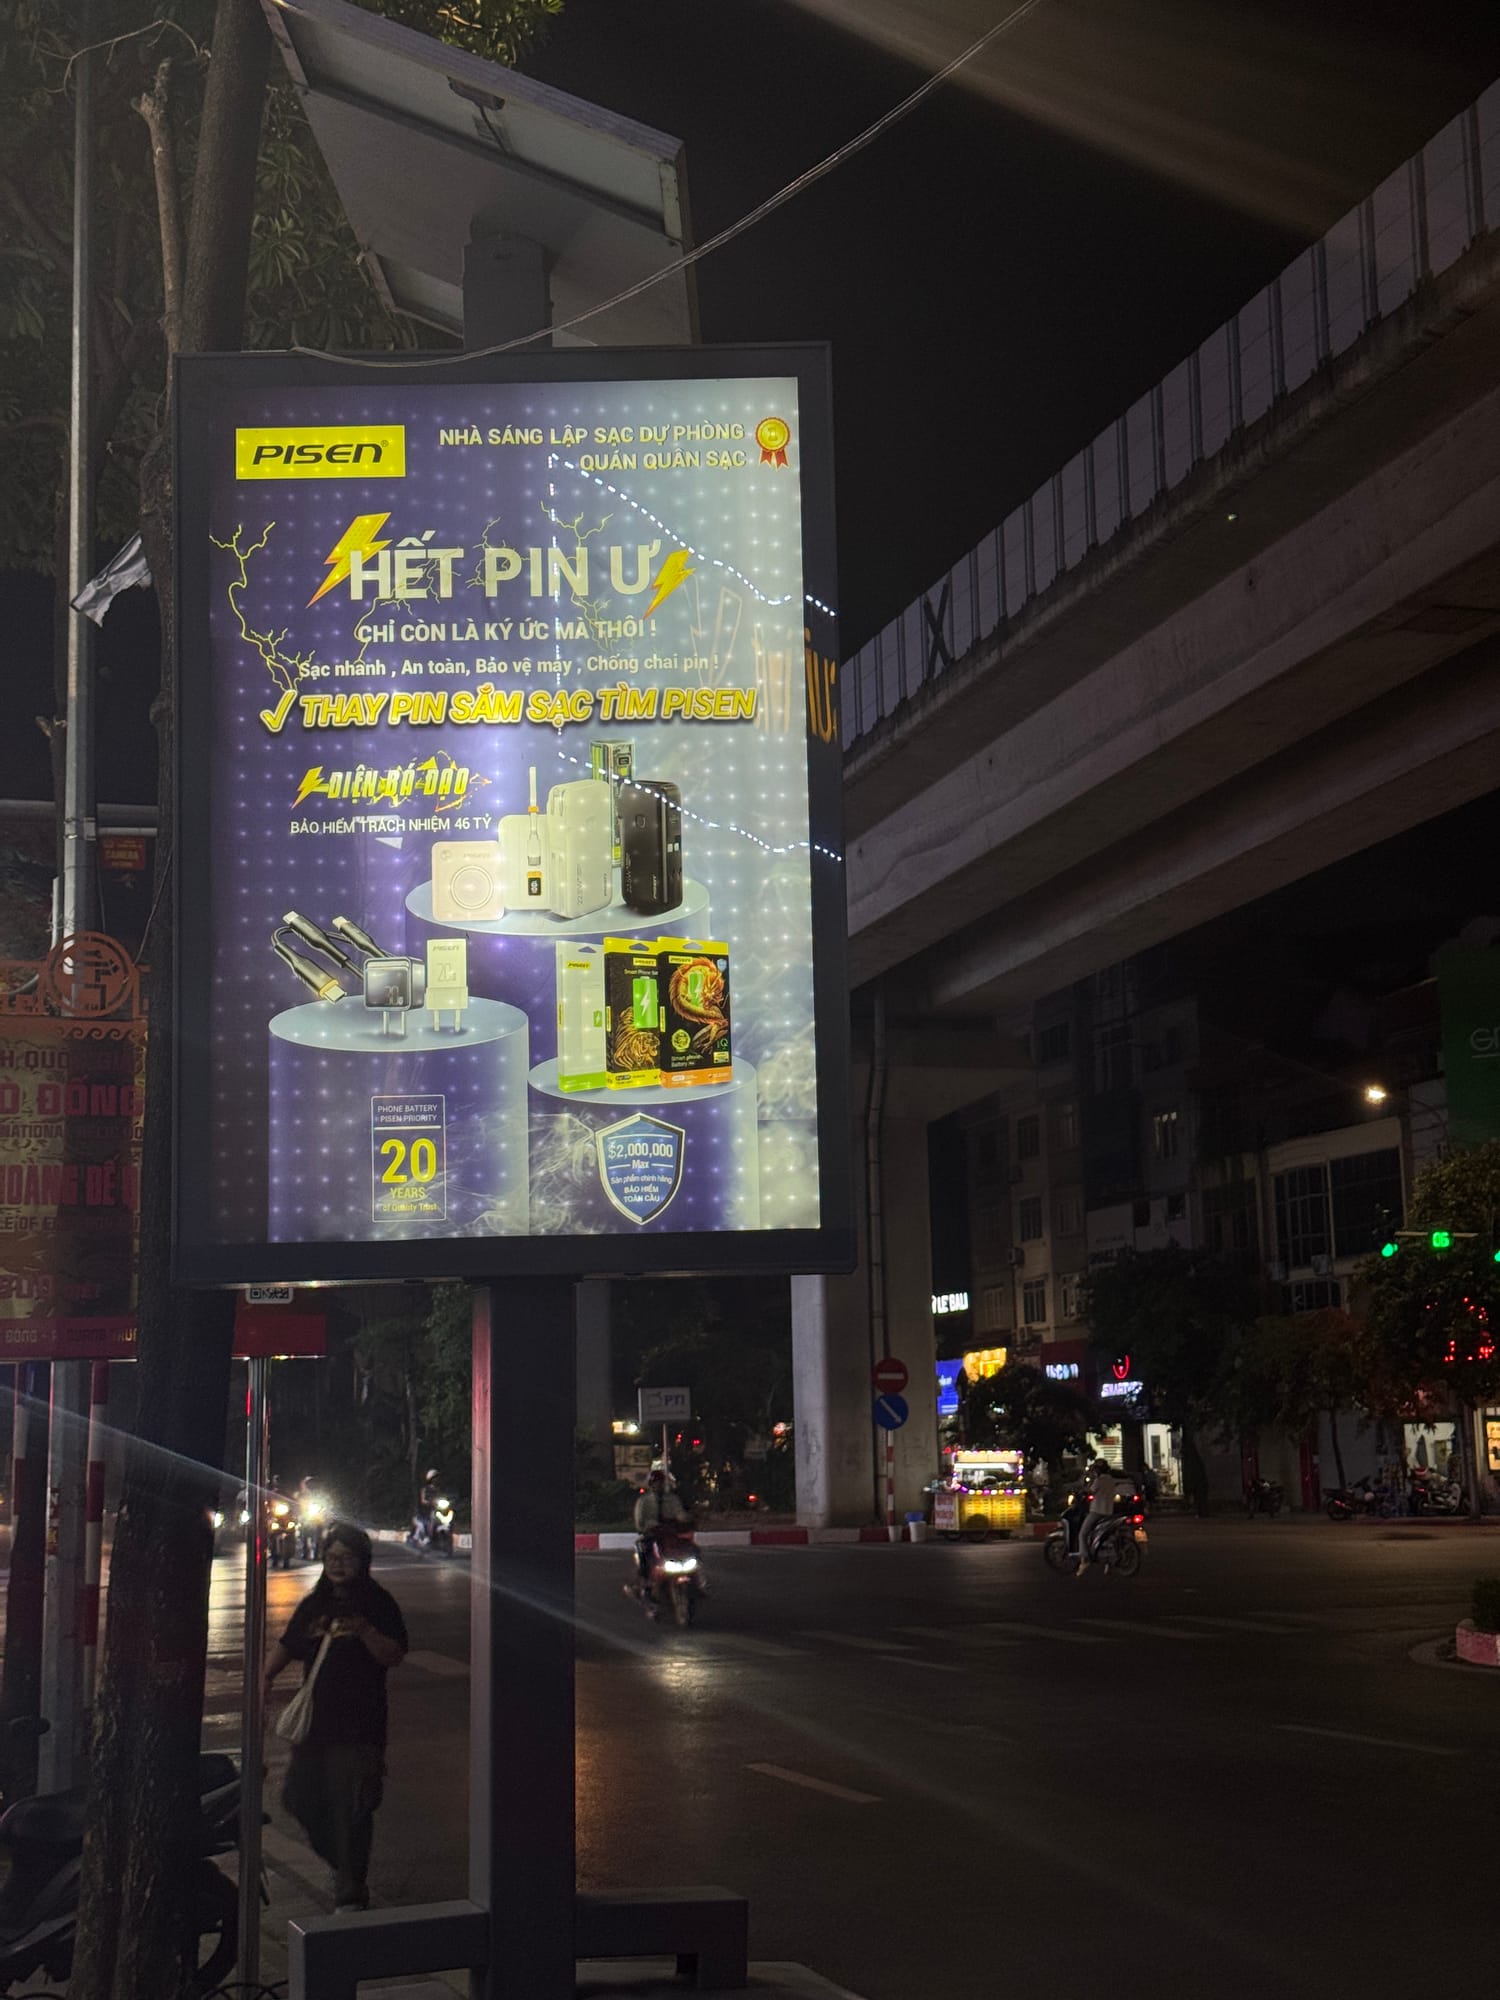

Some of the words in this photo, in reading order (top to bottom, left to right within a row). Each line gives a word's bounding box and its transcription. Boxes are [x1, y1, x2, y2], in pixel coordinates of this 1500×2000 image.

[440, 425, 483, 445] NHÀ
[488, 424, 543, 445] SÁNG
[550, 424, 588, 447] LẬP
[594, 427, 634, 446] SẠC
[639, 424, 669, 445] DỰ
[673, 420, 744, 441] PHÒNG
[580, 450, 637, 471] QUÁN
[643, 448, 700, 470] QUÂN
[706, 451, 746, 469] SẠC
[350, 530, 464, 600] HẾT
[484, 547, 590, 597] PIN
[357, 619, 394, 642] CHỈ
[401, 619, 446, 641] CÒN
[452, 618, 481, 641] LÀ
[485, 617, 513, 640] KÝ
[519, 617, 549, 640] ỨC
[556, 617, 589, 639] MÀ
[594, 615, 644, 638] THÔI
[300, 662, 330, 680] Sạc
[335, 659, 386, 676] nhanh
[402, 660, 423, 675] An
[428, 657, 471, 677] toàn,
[475, 656, 508, 674] Bảo
[513, 659, 532, 679] vệ
[587, 653, 639, 674] Chống
[644, 652, 677, 669] chai
[683, 653, 708, 672] pin
[300, 693, 386, 727] THAY
[388, 691, 447, 725] PIN
[450, 682, 524, 725] SẮM
[526, 688, 594, 728] SẠC
[598, 681, 657, 719] TÌM
[661, 687, 757, 719] PISEN
[290, 818, 318, 834] BẢO
[322, 816, 355, 834] HIỂM
[360, 815, 406, 832] TRÁCH
[409, 815, 450, 832] NHIỆM
[454, 818, 470, 830] 46
[473, 813, 491, 829] TỶ
[378, 1105, 403, 1113] PHONE
[405, 1104, 437, 1112] BATTERY
[380, 1114, 402, 1122] PISEN
[403, 1114, 437, 1122] PRIORITY
[381, 1138, 436, 1183] 20
[608, 1142, 673, 1159] $2,000,000
[632, 1160, 650, 1169] Max
[390, 1187, 426, 1199] YEARS
